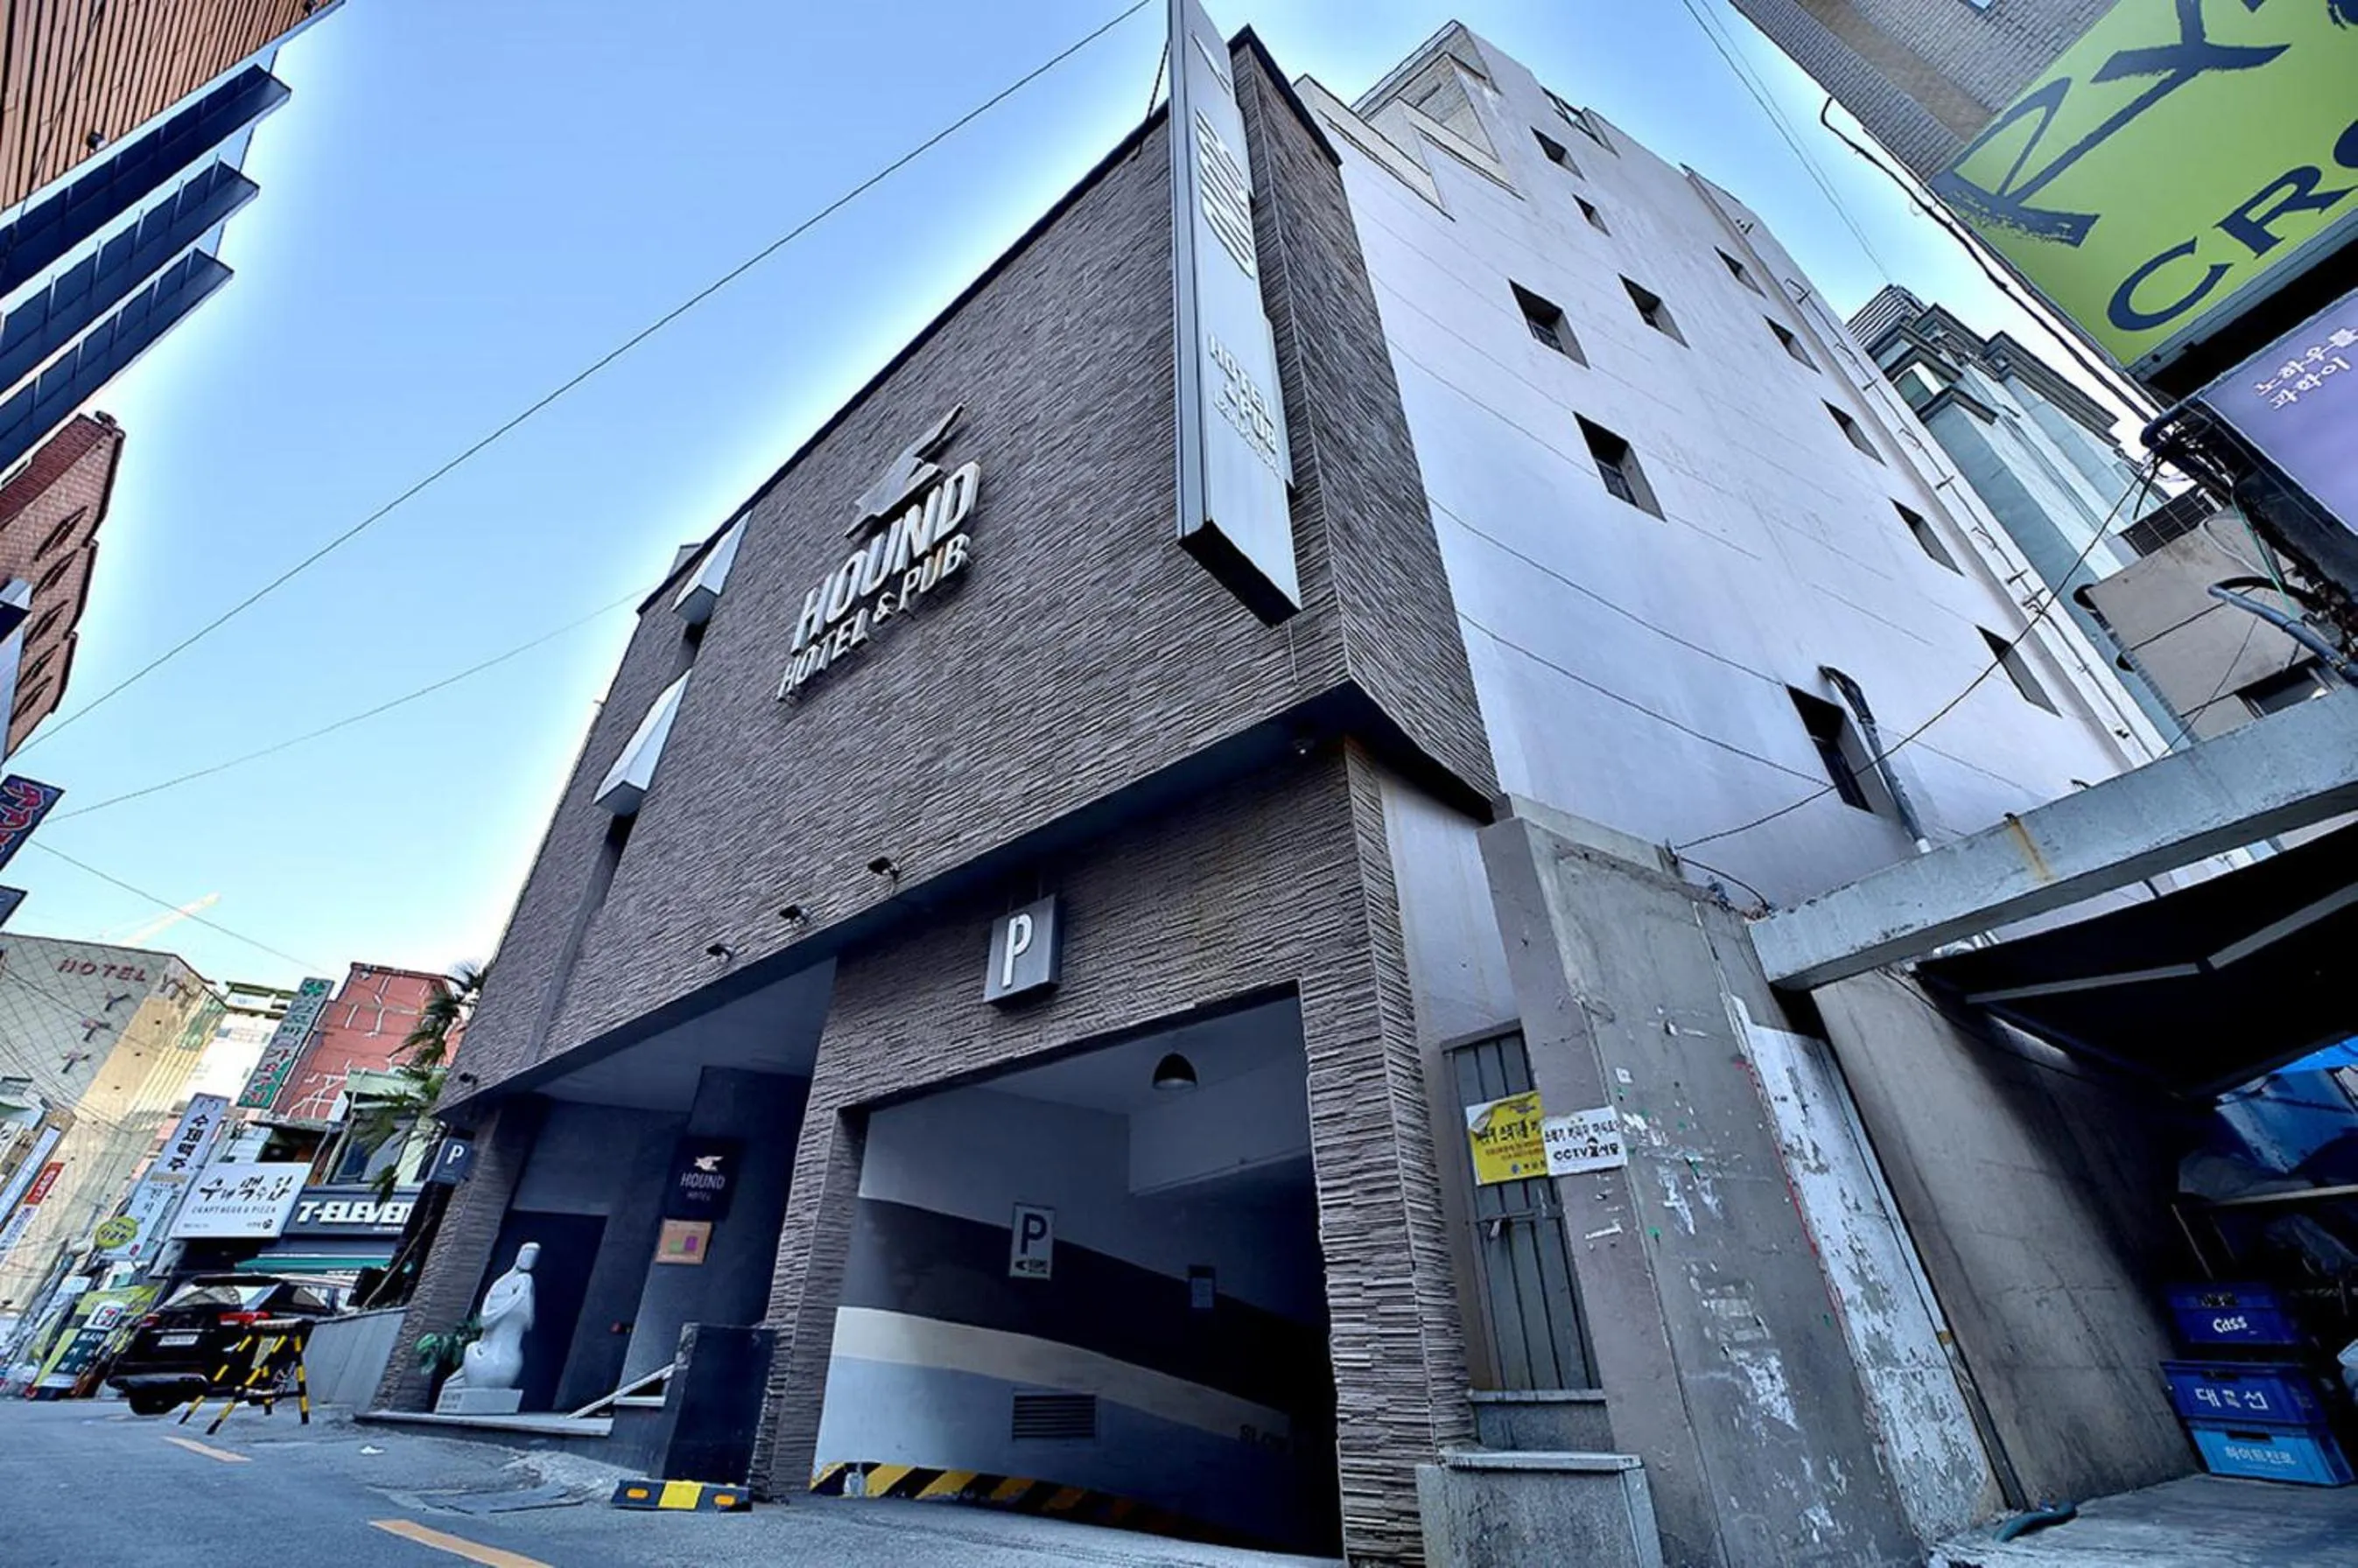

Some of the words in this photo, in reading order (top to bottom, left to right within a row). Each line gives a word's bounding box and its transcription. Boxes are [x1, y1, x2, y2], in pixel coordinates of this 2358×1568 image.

[1928, 0, 2358, 248] RY
[1208, 332, 1274, 429] HOTEL
[1239, 396, 1277, 455] PUB
[790, 460, 981, 655] HOUND
[777, 607, 870, 702] HOTEL
[872, 592, 899, 625] &
[899, 533, 972, 614] PUB
[57, 956, 146, 982] HOTEL
[1001, 912, 1034, 989] P
[446, 1144, 465, 1164] P
[679, 1172, 726, 1190] HOUND
[1020, 1213, 1048, 1254] P
[2213, 1315, 2248, 1334] Cass
